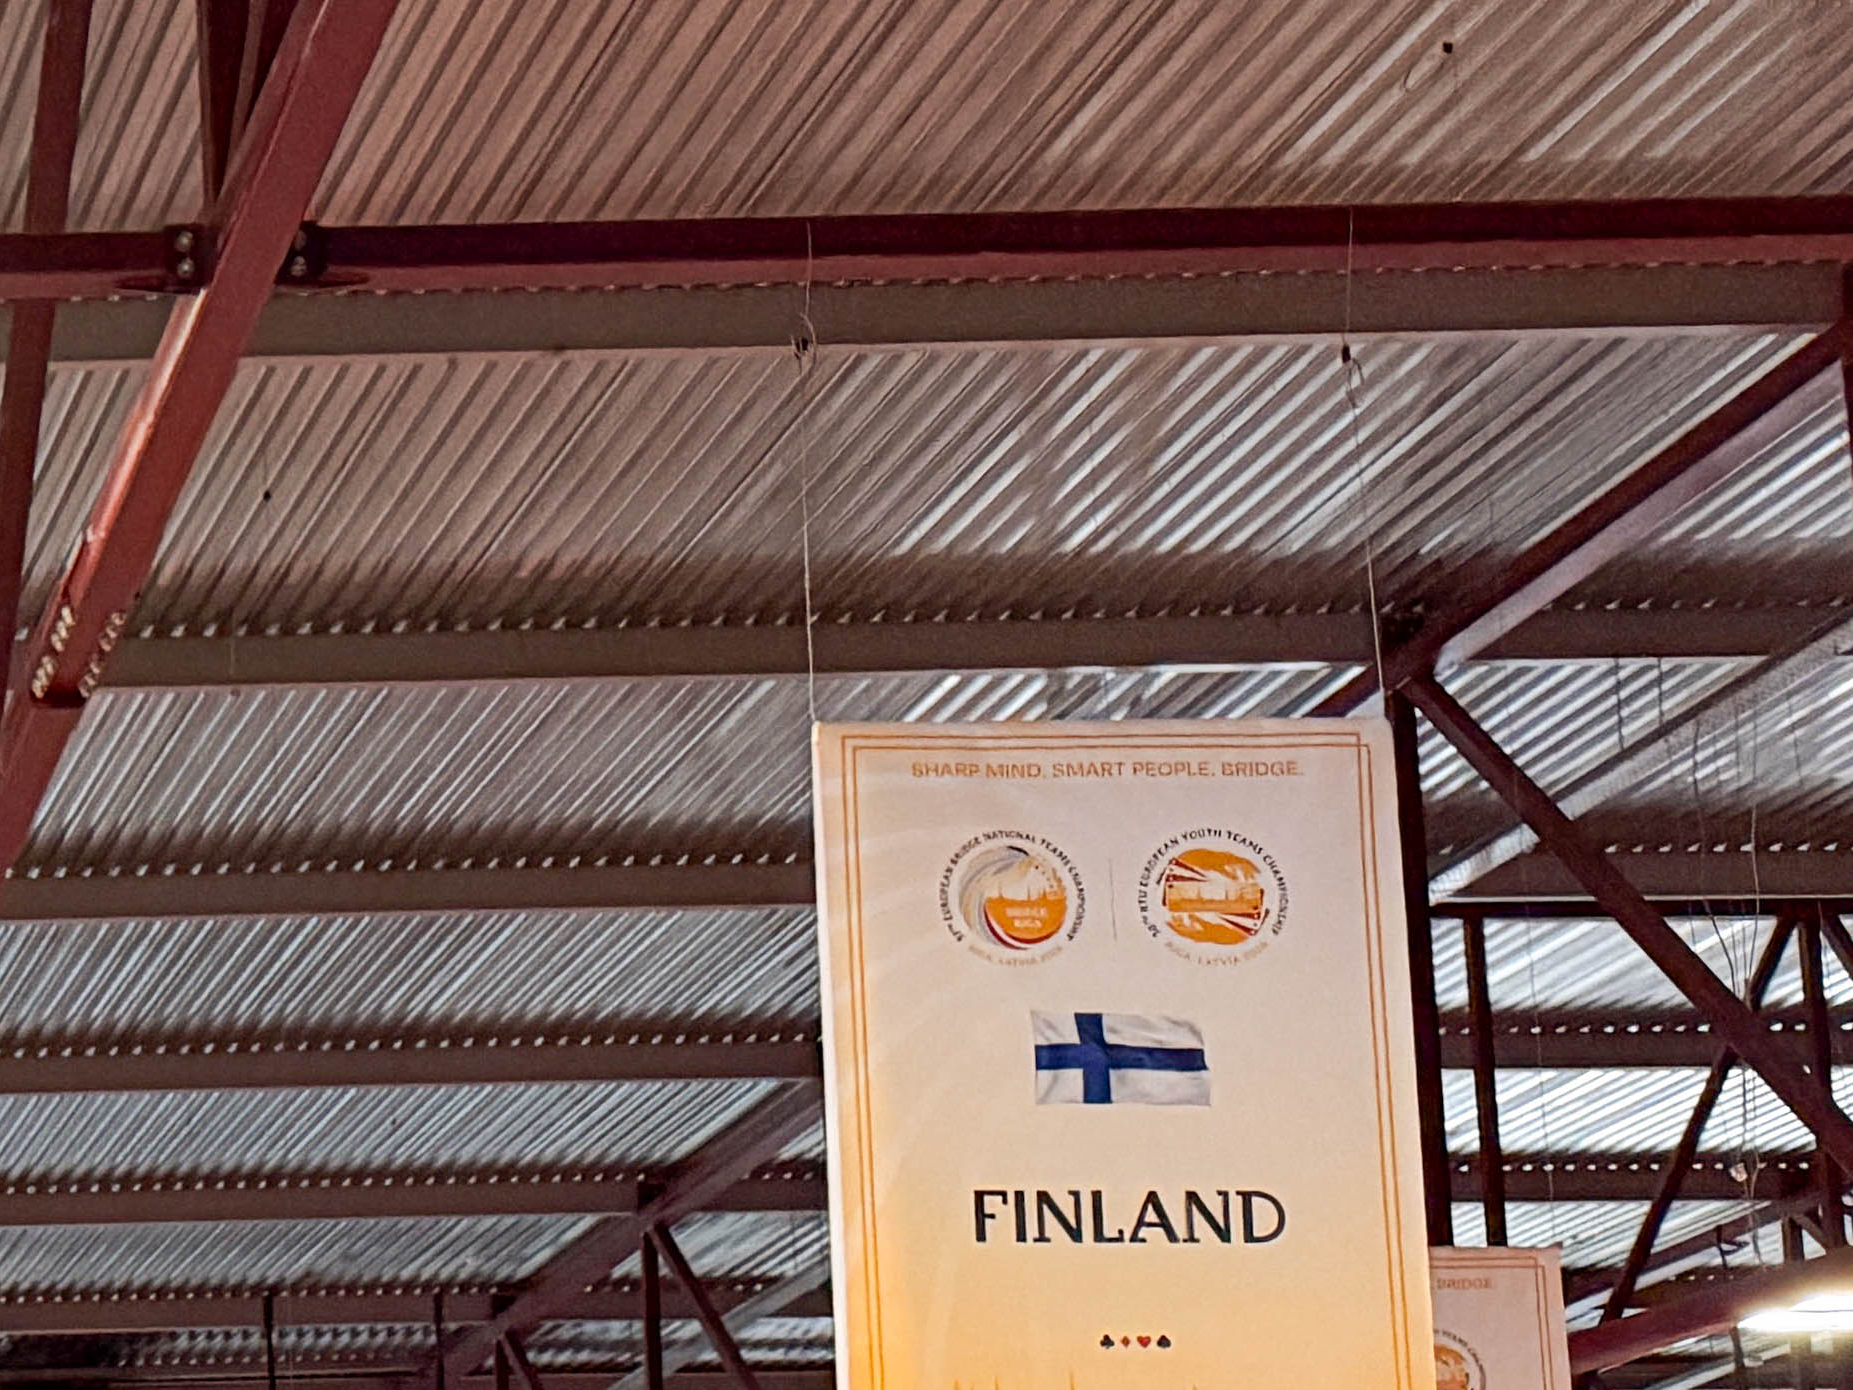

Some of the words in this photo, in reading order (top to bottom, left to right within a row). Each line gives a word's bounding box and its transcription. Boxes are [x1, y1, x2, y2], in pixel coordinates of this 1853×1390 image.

[912, 760, 981, 779] SHARP
[1052, 760, 1126, 779] SMART
[1182, 828, 1222, 841] YOUTH
[1226, 829, 1264, 855] TEAMS
[973, 1189, 1287, 1244] FINLAND
